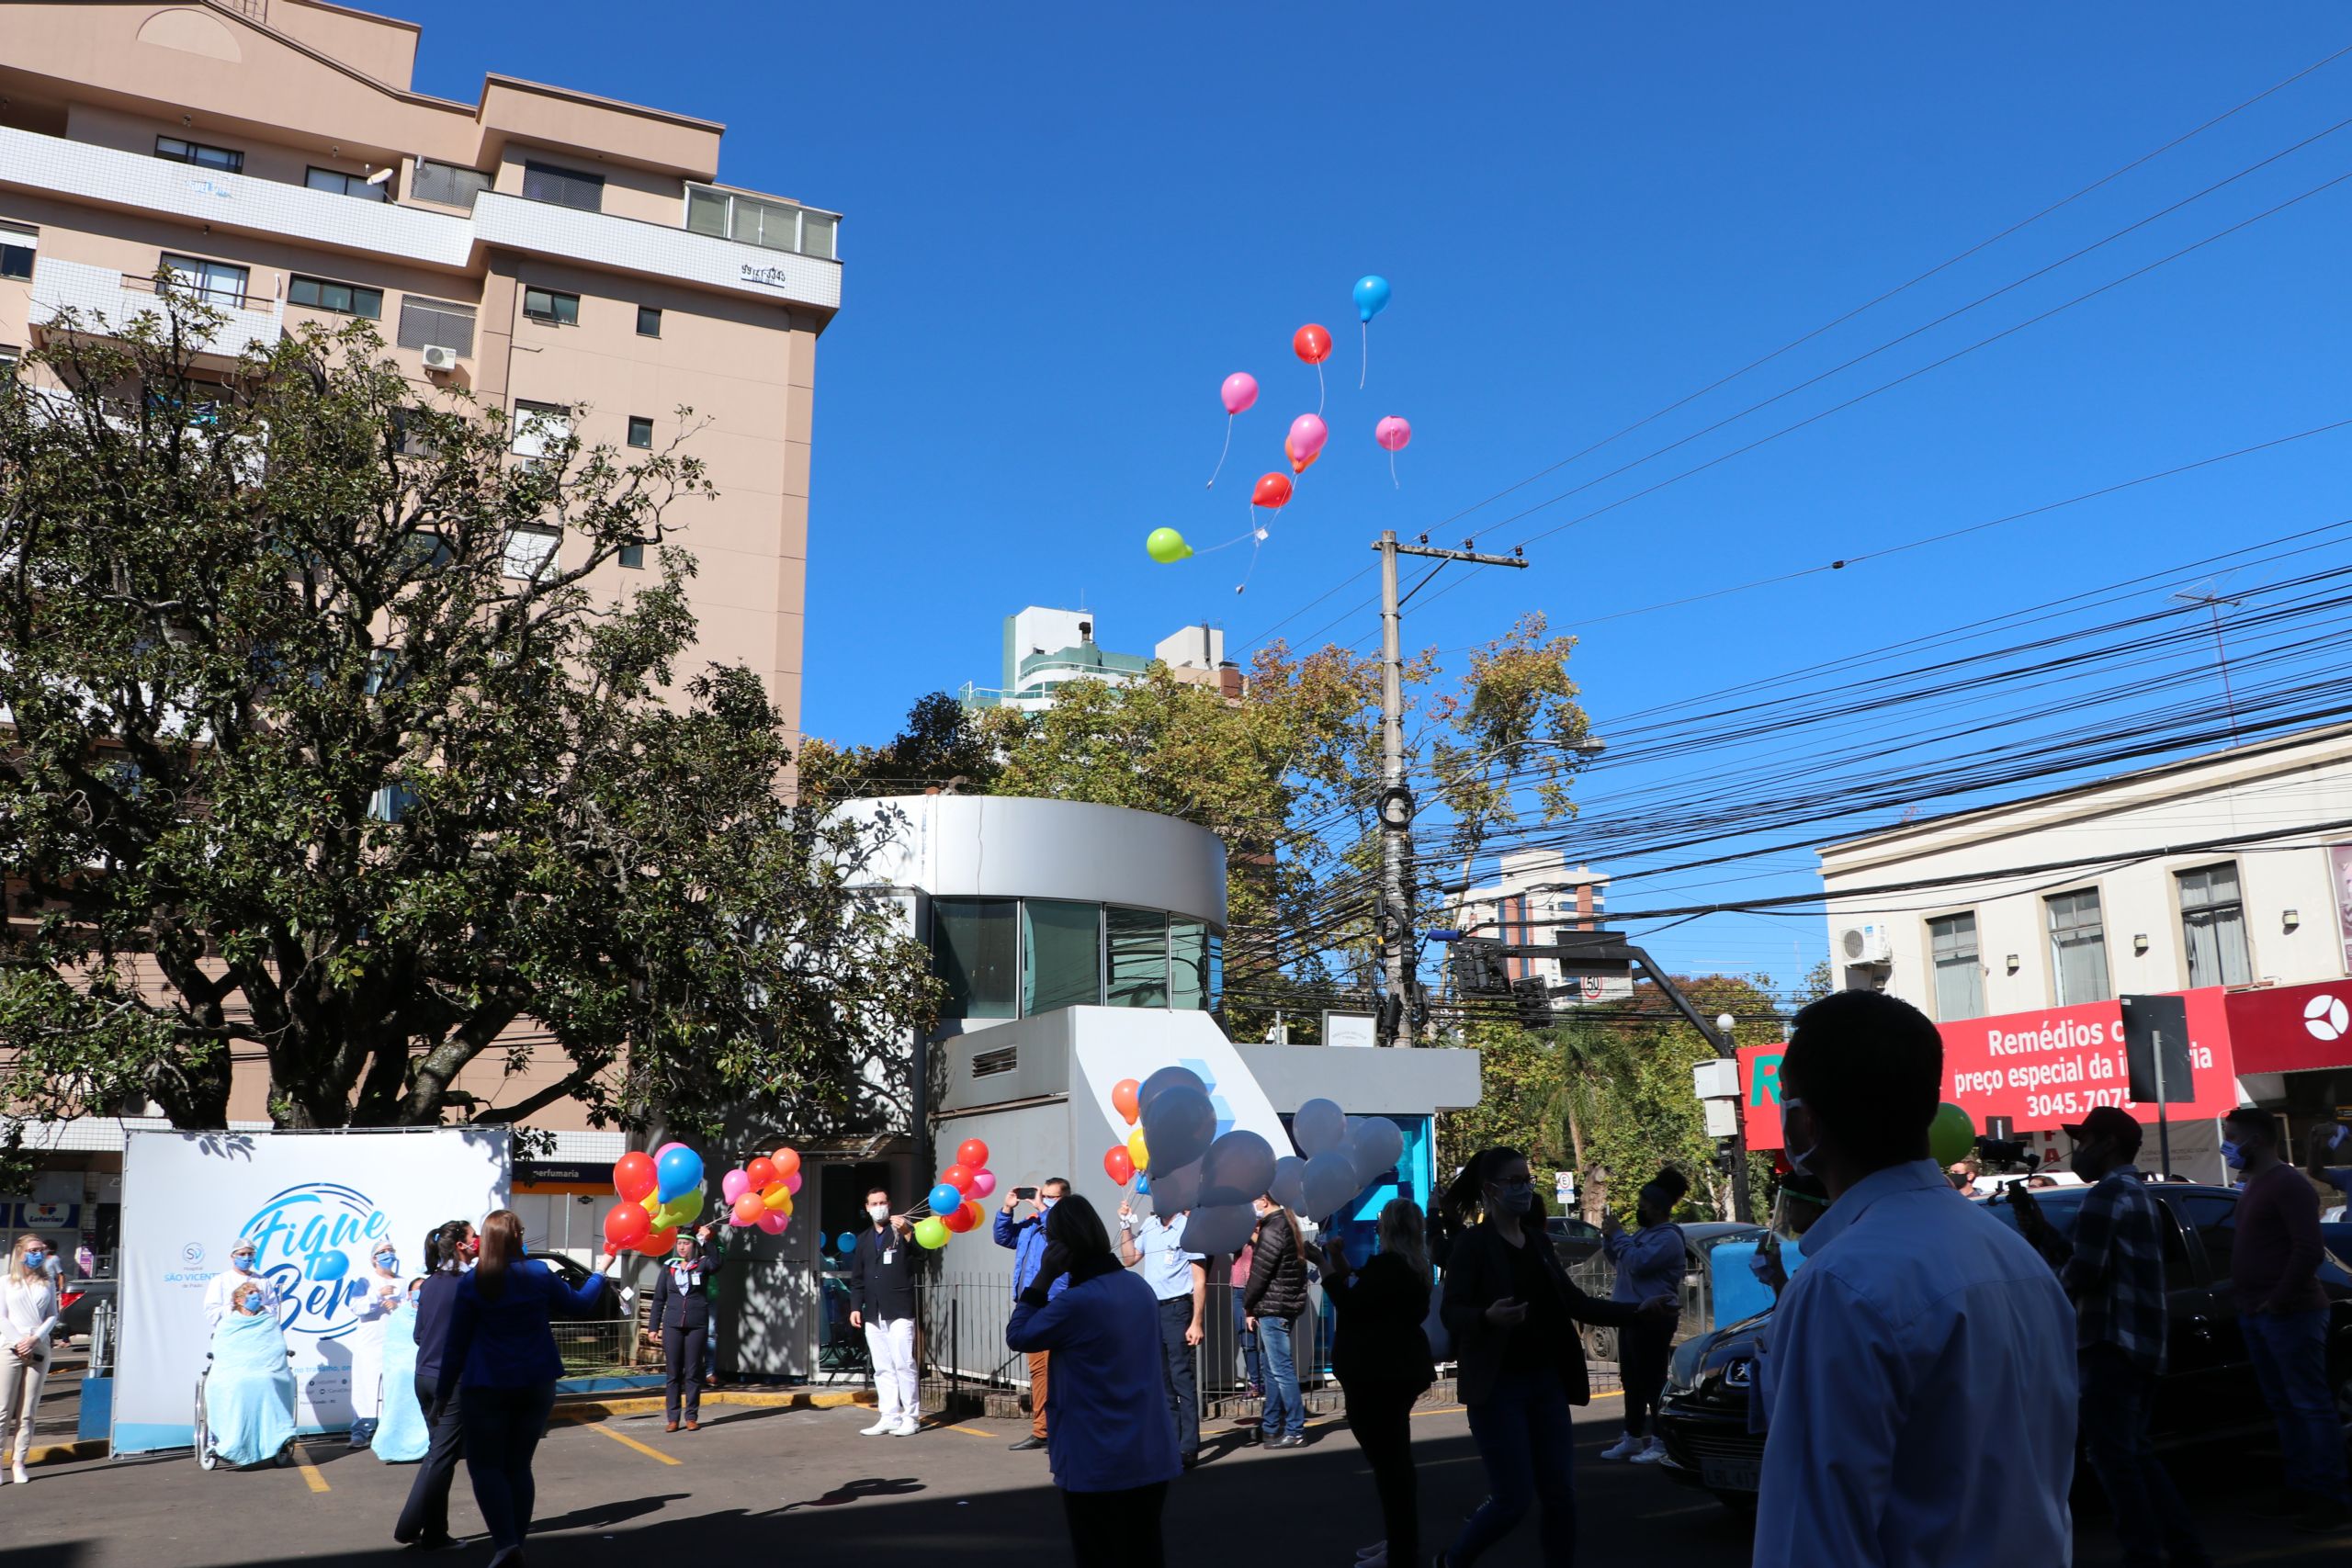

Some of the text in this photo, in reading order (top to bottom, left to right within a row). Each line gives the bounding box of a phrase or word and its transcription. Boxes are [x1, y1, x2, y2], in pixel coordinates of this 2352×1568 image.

[1988, 1021, 2104, 1056] Remédios
[1954, 1068, 2003, 1098] preço
[2008, 1055, 2084, 1091] especial
[2088, 1053, 2113, 1079] da
[2027, 1088, 2137, 1117] 3045.7075
